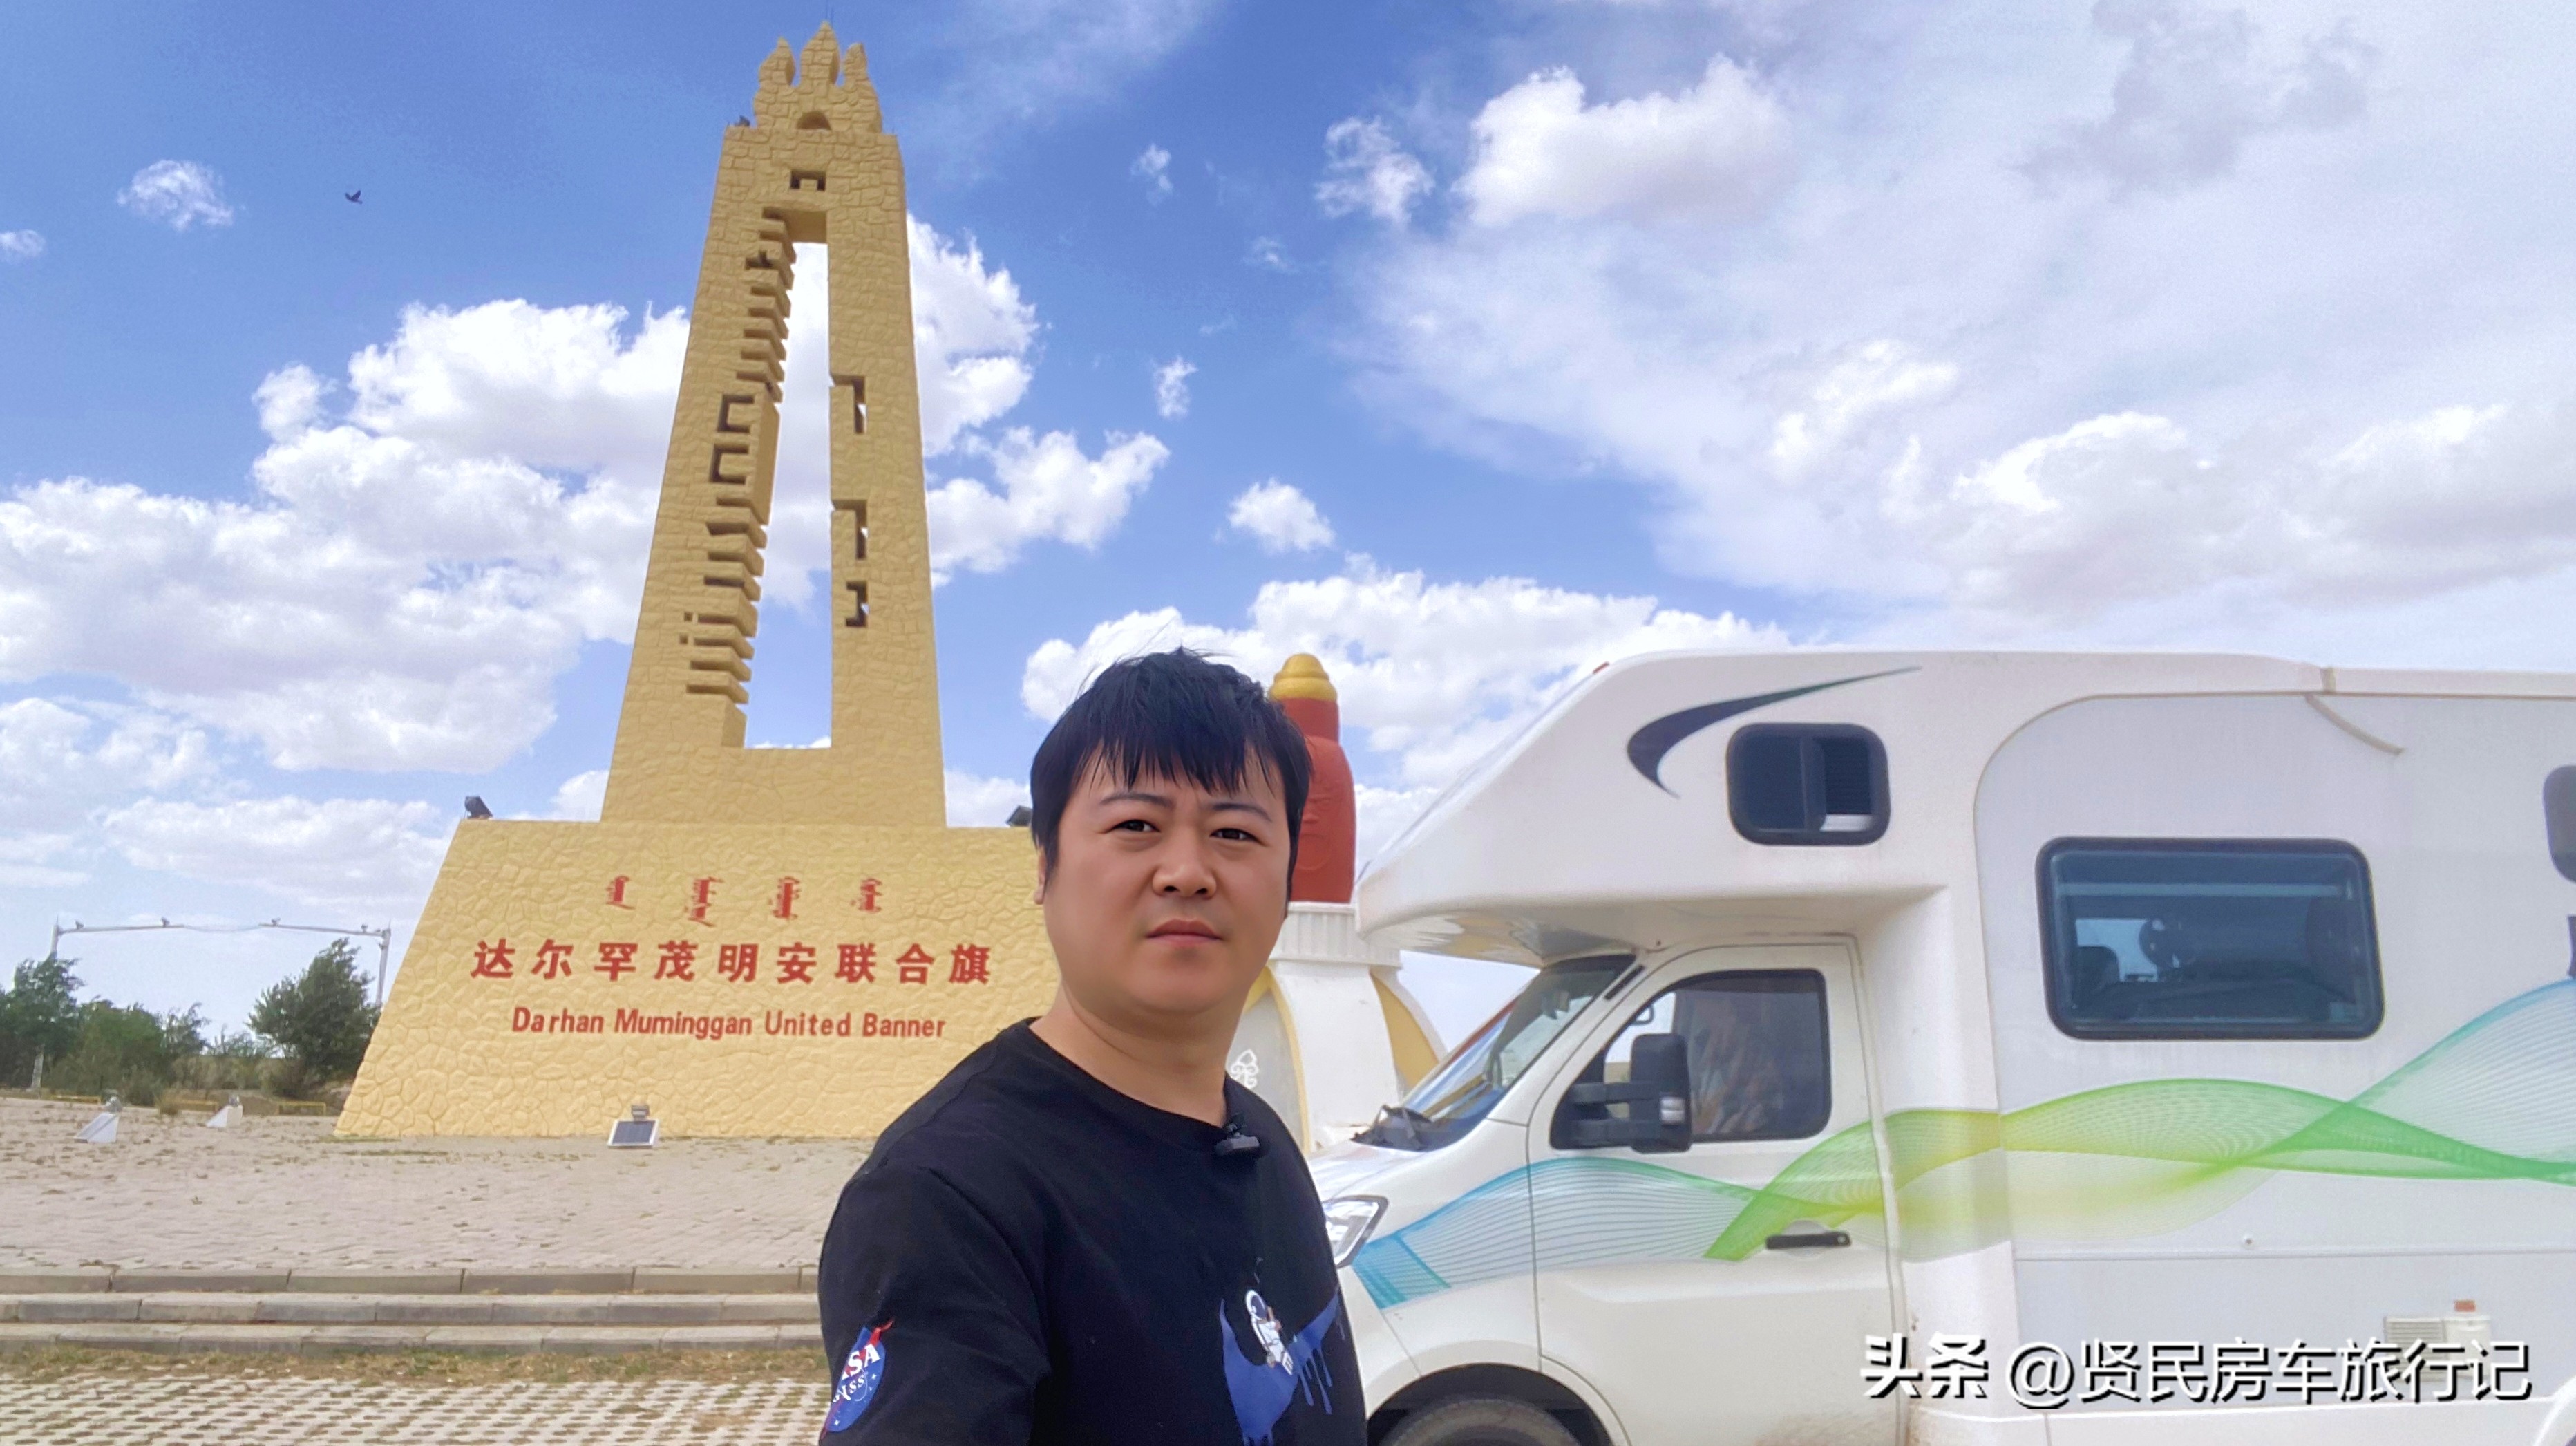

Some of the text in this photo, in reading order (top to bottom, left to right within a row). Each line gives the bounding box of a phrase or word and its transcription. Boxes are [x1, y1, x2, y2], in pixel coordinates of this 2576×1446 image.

[470, 938, 992, 986] 达尔罕茂明安联合旗
[512, 1006, 946, 1041] Darhan Muminggan United Banner
